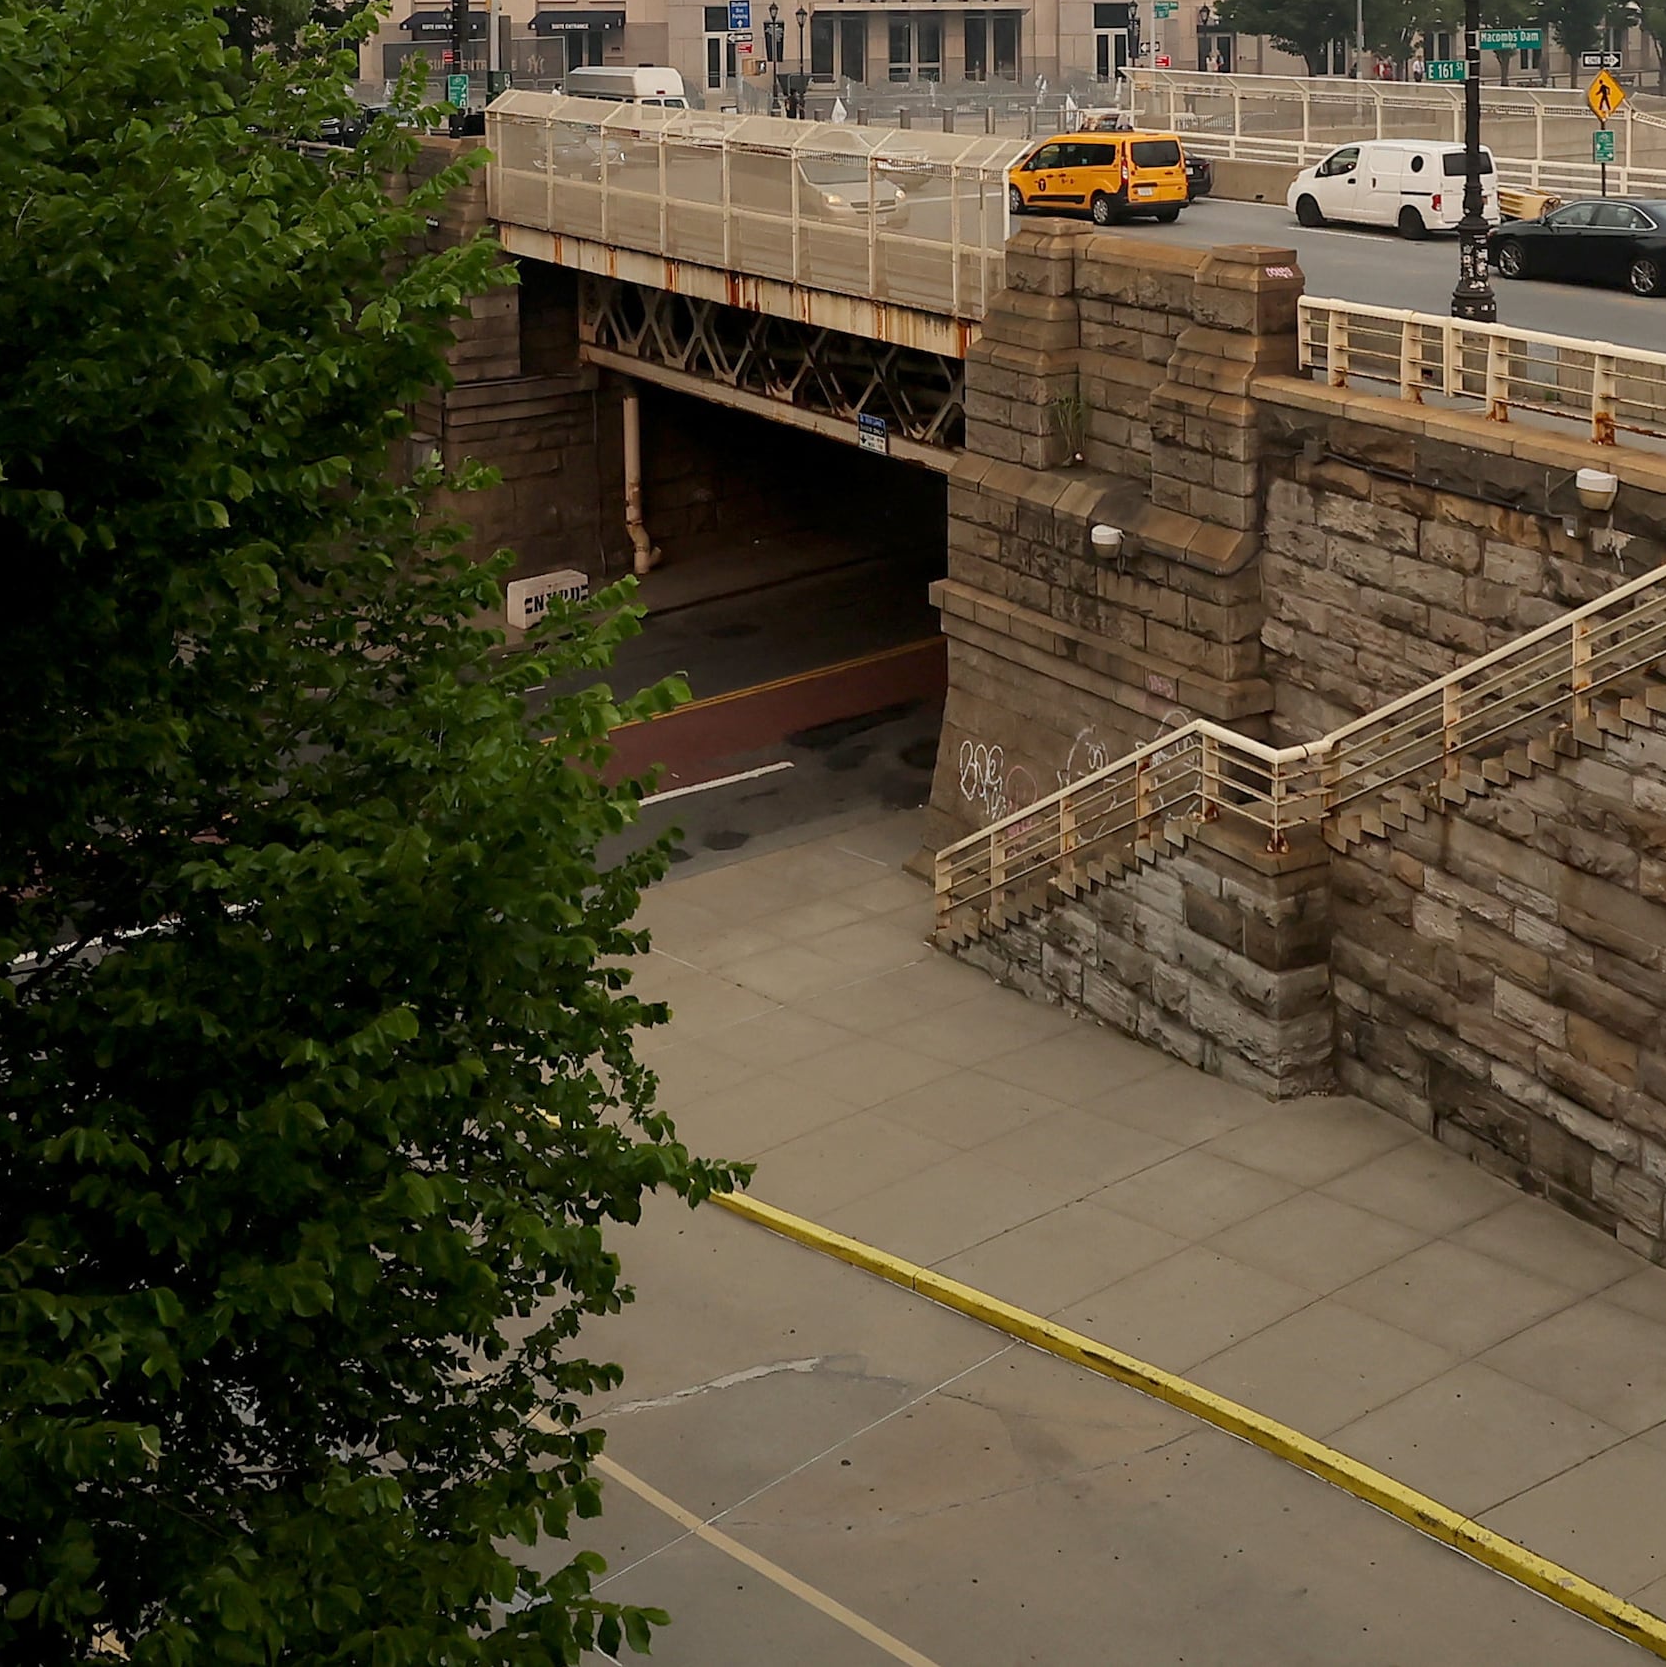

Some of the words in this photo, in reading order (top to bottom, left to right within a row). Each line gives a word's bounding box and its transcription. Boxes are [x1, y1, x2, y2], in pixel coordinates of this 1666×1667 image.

[1520, 31, 1539, 42] Dam
[1428, 64, 1434, 79] E
[1438, 63, 1453, 78] 161
